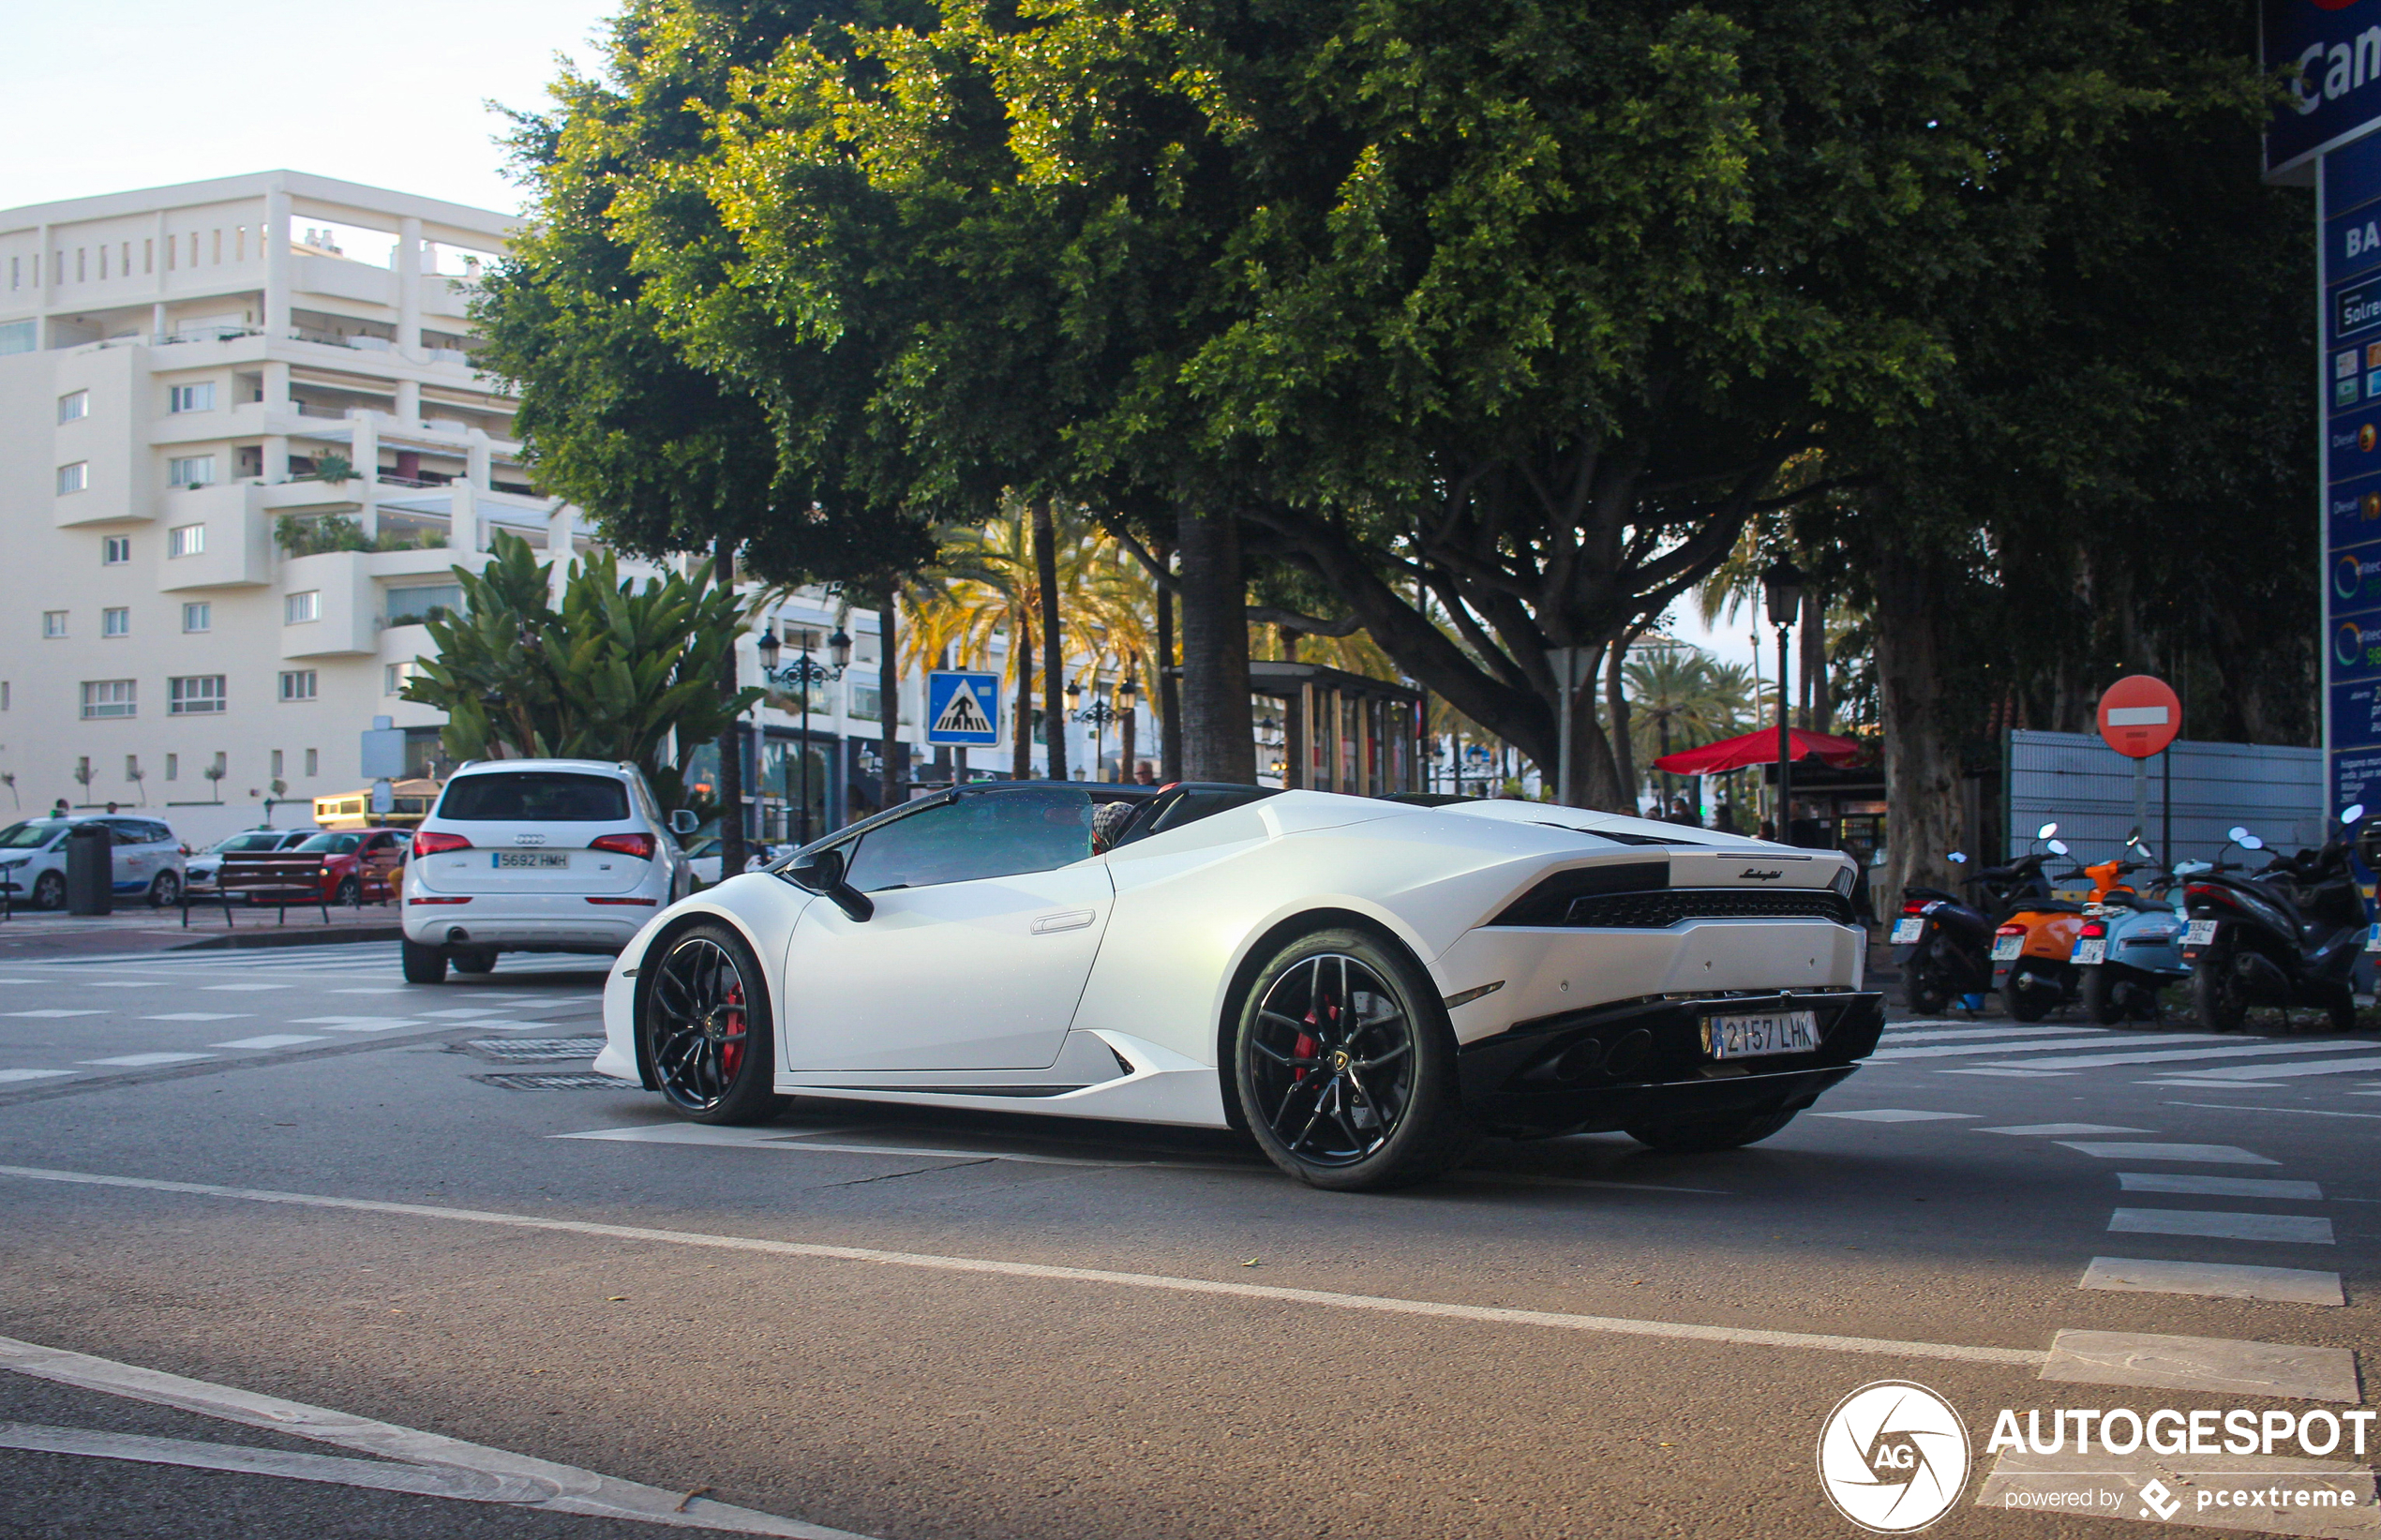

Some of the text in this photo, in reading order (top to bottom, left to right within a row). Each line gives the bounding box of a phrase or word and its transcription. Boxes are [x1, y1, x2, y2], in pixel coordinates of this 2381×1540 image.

[2345, 221, 2381, 259] BA
[502, 854, 566, 867] 5692 HMH
[1726, 1015, 1812, 1053] 2157 LHK
